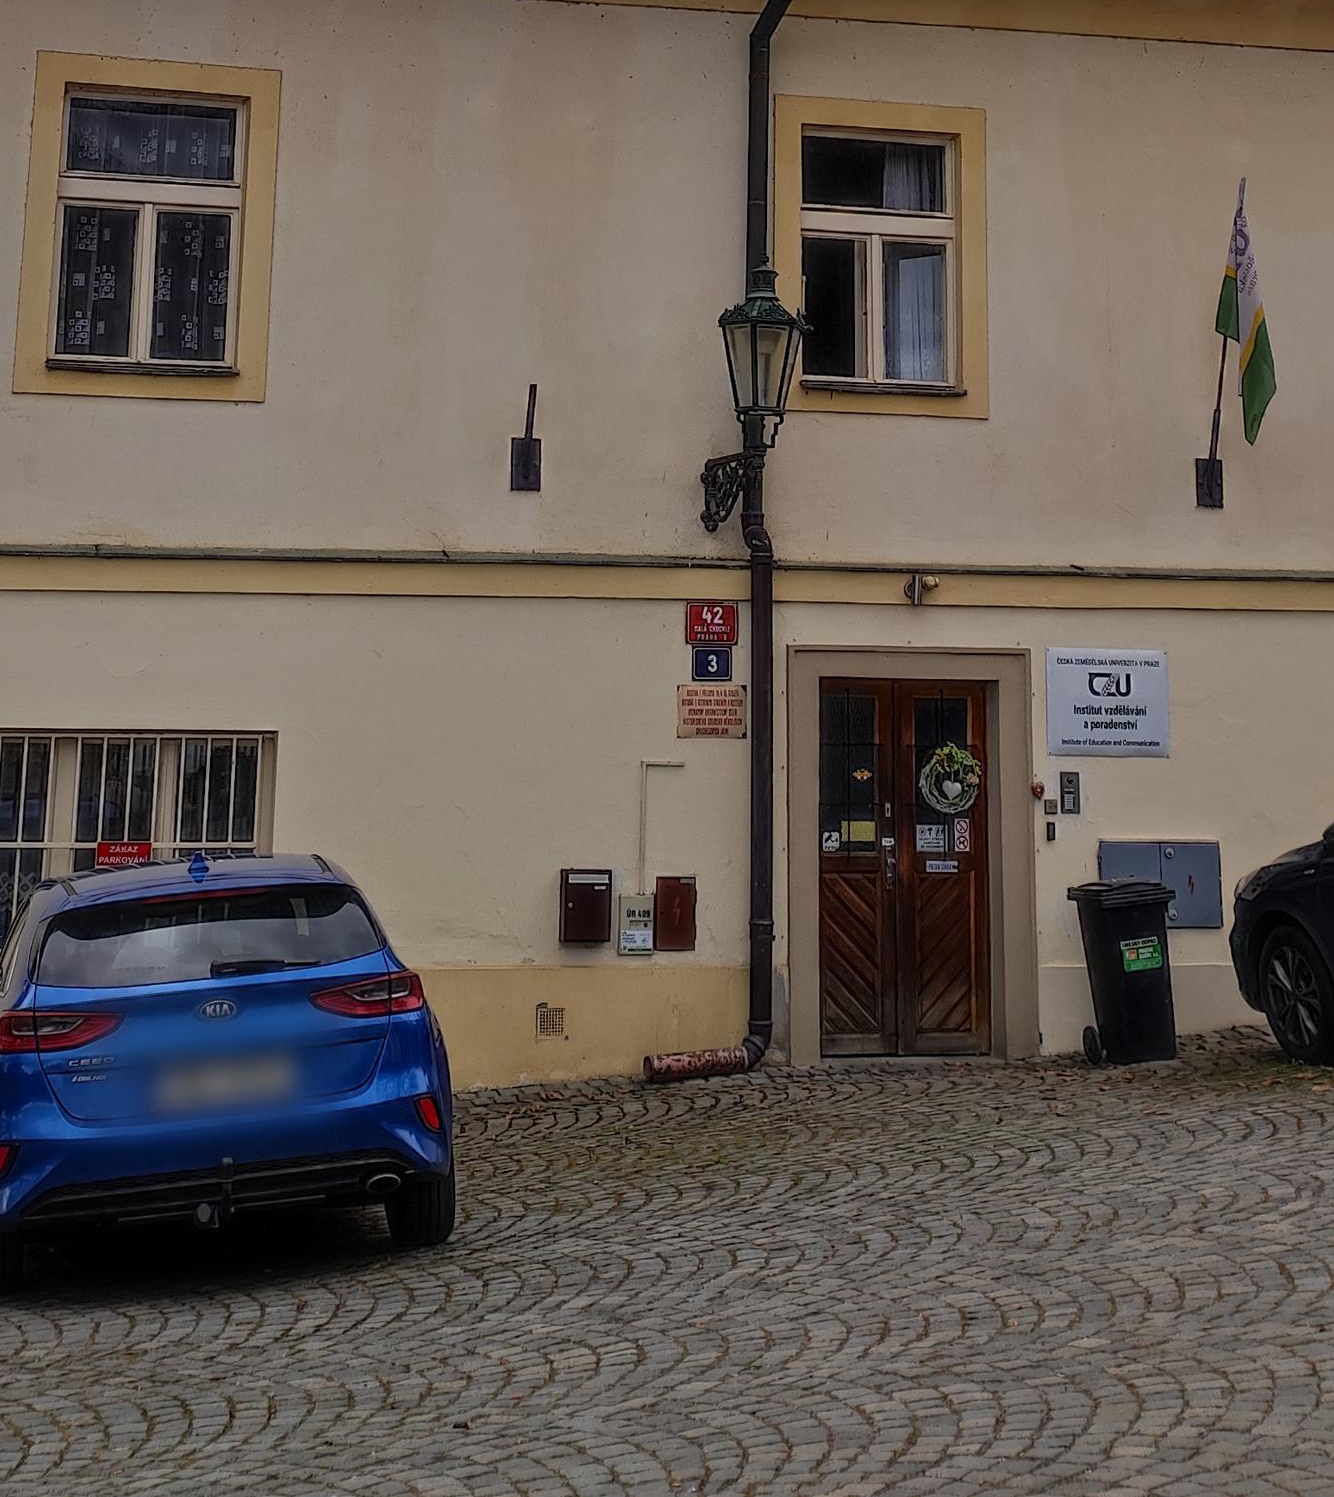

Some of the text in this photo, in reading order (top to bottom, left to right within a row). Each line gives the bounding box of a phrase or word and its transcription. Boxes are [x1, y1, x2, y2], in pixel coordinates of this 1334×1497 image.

[701, 606, 724, 623] 42
[707, 654, 718, 672] 3
[1056, 657, 1074, 665] ČESKÁ
[1074, 657, 1107, 666] ZEMĚDĚLSKÁ
[1108, 659, 1138, 667] UNIVERZITA
[1144, 660, 1160, 668] PRAZE
[1073, 704, 1147, 716] Institut vzdělávání
[1083, 719, 1138, 731] a poradenství
[1122, 739, 1160, 747] Communication
[109, 844, 138, 853] ZÁKAZ
[98, 855, 148, 864] PARKOVÁNÍ
[206, 1004, 230, 1017] KIA
